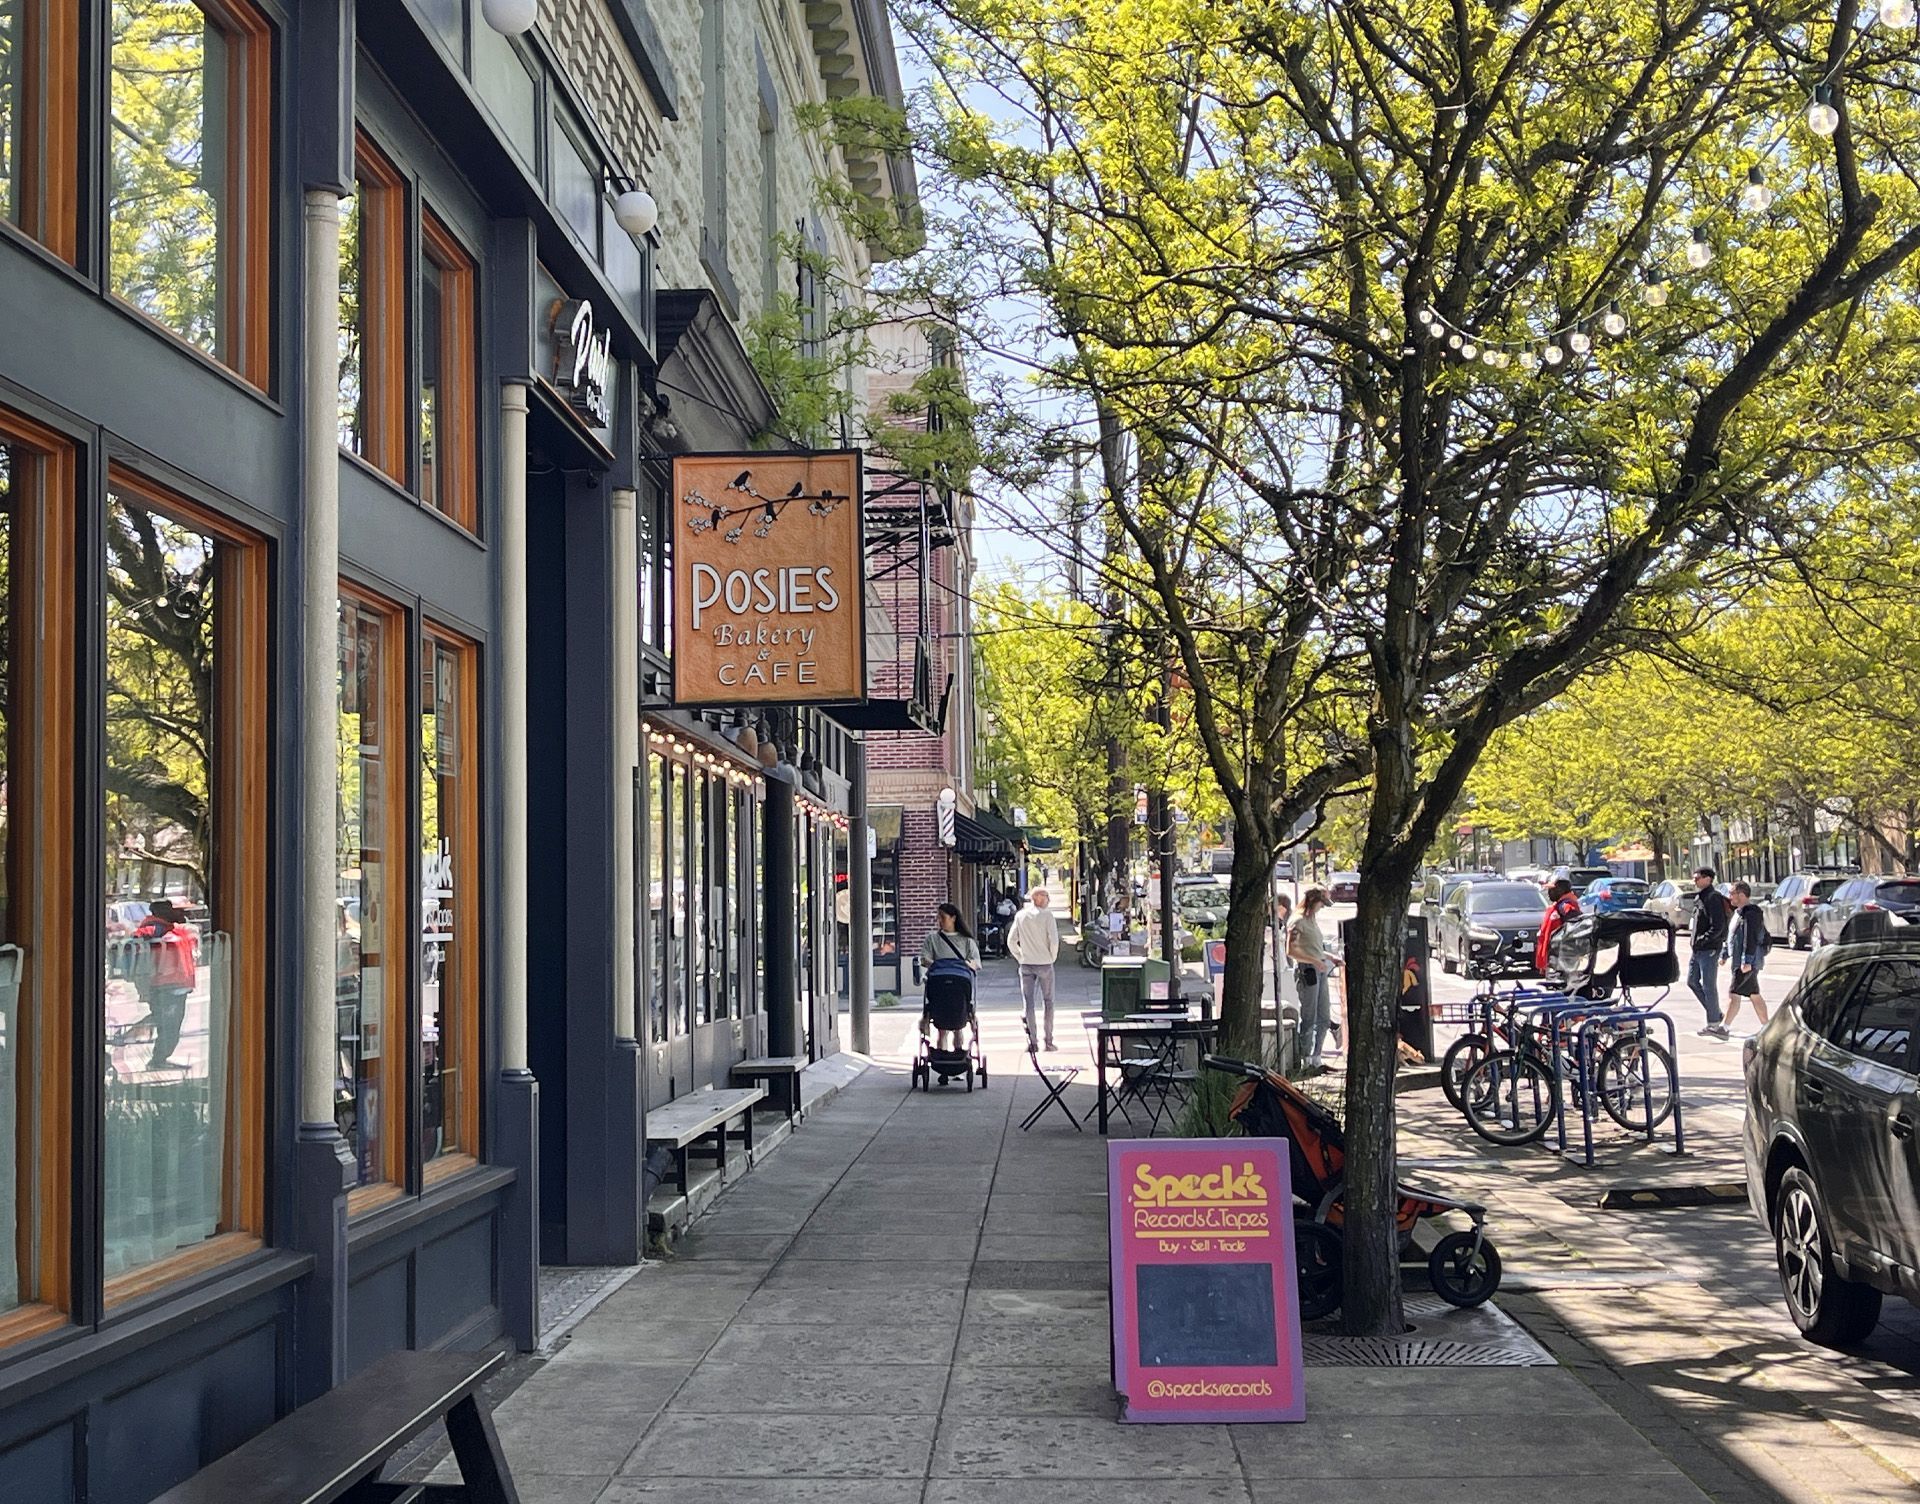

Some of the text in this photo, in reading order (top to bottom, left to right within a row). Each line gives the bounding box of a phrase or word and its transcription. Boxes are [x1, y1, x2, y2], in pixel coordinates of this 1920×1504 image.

[692, 562, 839, 630] POSIES
[713, 617, 815, 656] Bakery
[757, 649, 772, 661] &
[718, 661, 817, 685] CAFE
[1133, 1162, 1268, 1207] Speck's
[1159, 1239, 1247, 1254] Buy Sell Trade
[1147, 1379, 1273, 1399] @specksrecords
